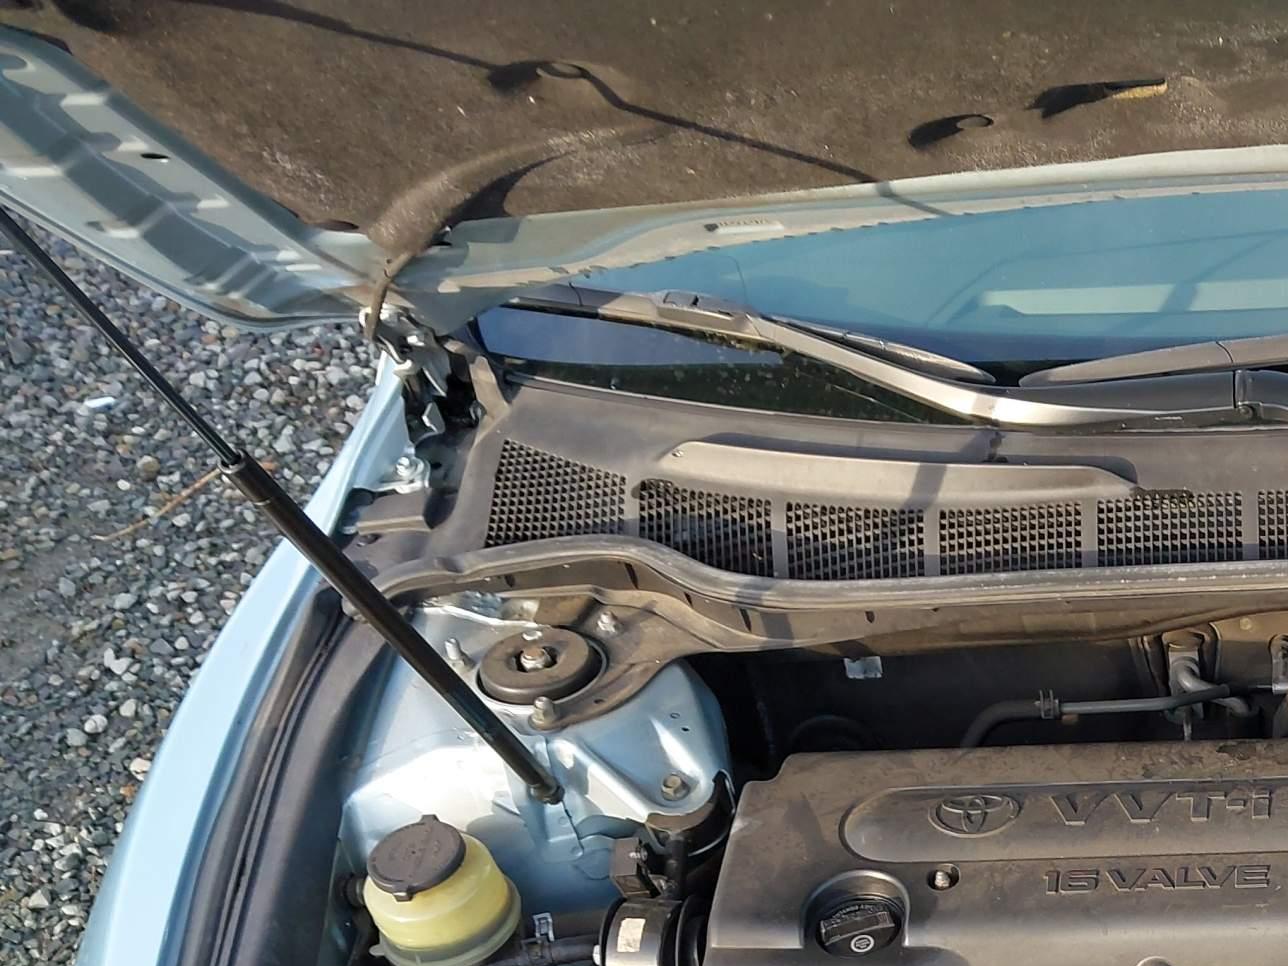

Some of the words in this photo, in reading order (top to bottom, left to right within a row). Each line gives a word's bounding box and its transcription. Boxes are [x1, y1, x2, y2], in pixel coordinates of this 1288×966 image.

[1050, 788, 1273, 825] VVT-i
[1045, 868, 1099, 894] 16
[1105, 864, 1271, 892] VALVE
